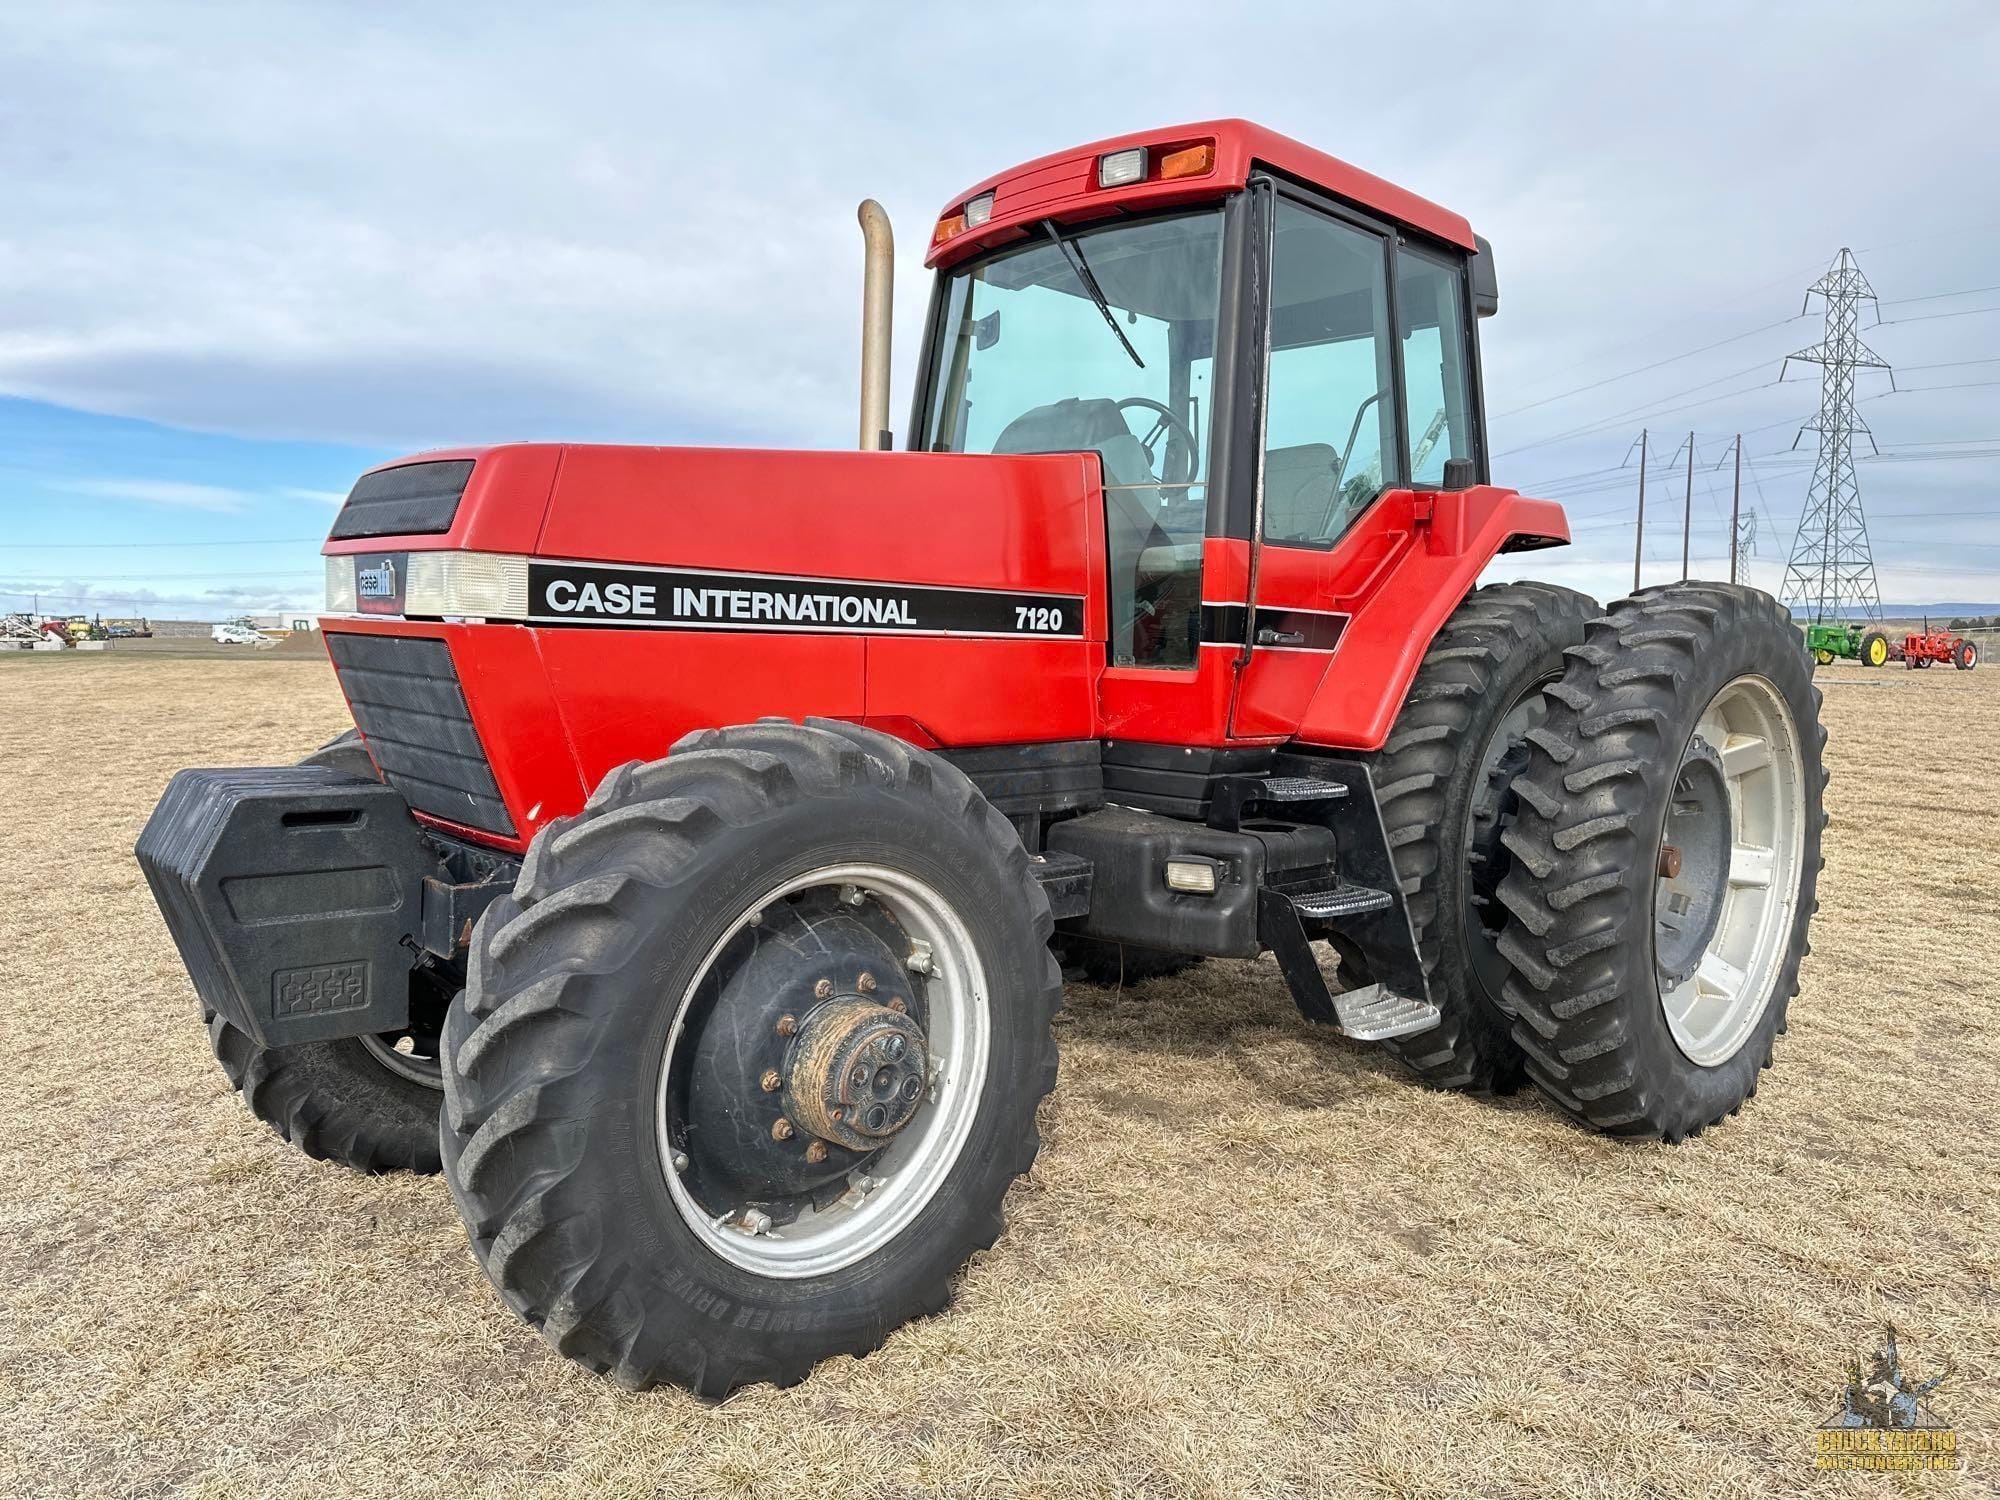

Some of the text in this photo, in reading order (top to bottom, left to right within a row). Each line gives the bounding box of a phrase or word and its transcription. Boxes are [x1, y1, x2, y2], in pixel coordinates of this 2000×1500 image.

[546, 580, 917, 625] CASE INTERNATIONAL
[1015, 606, 1063, 631] 7120
